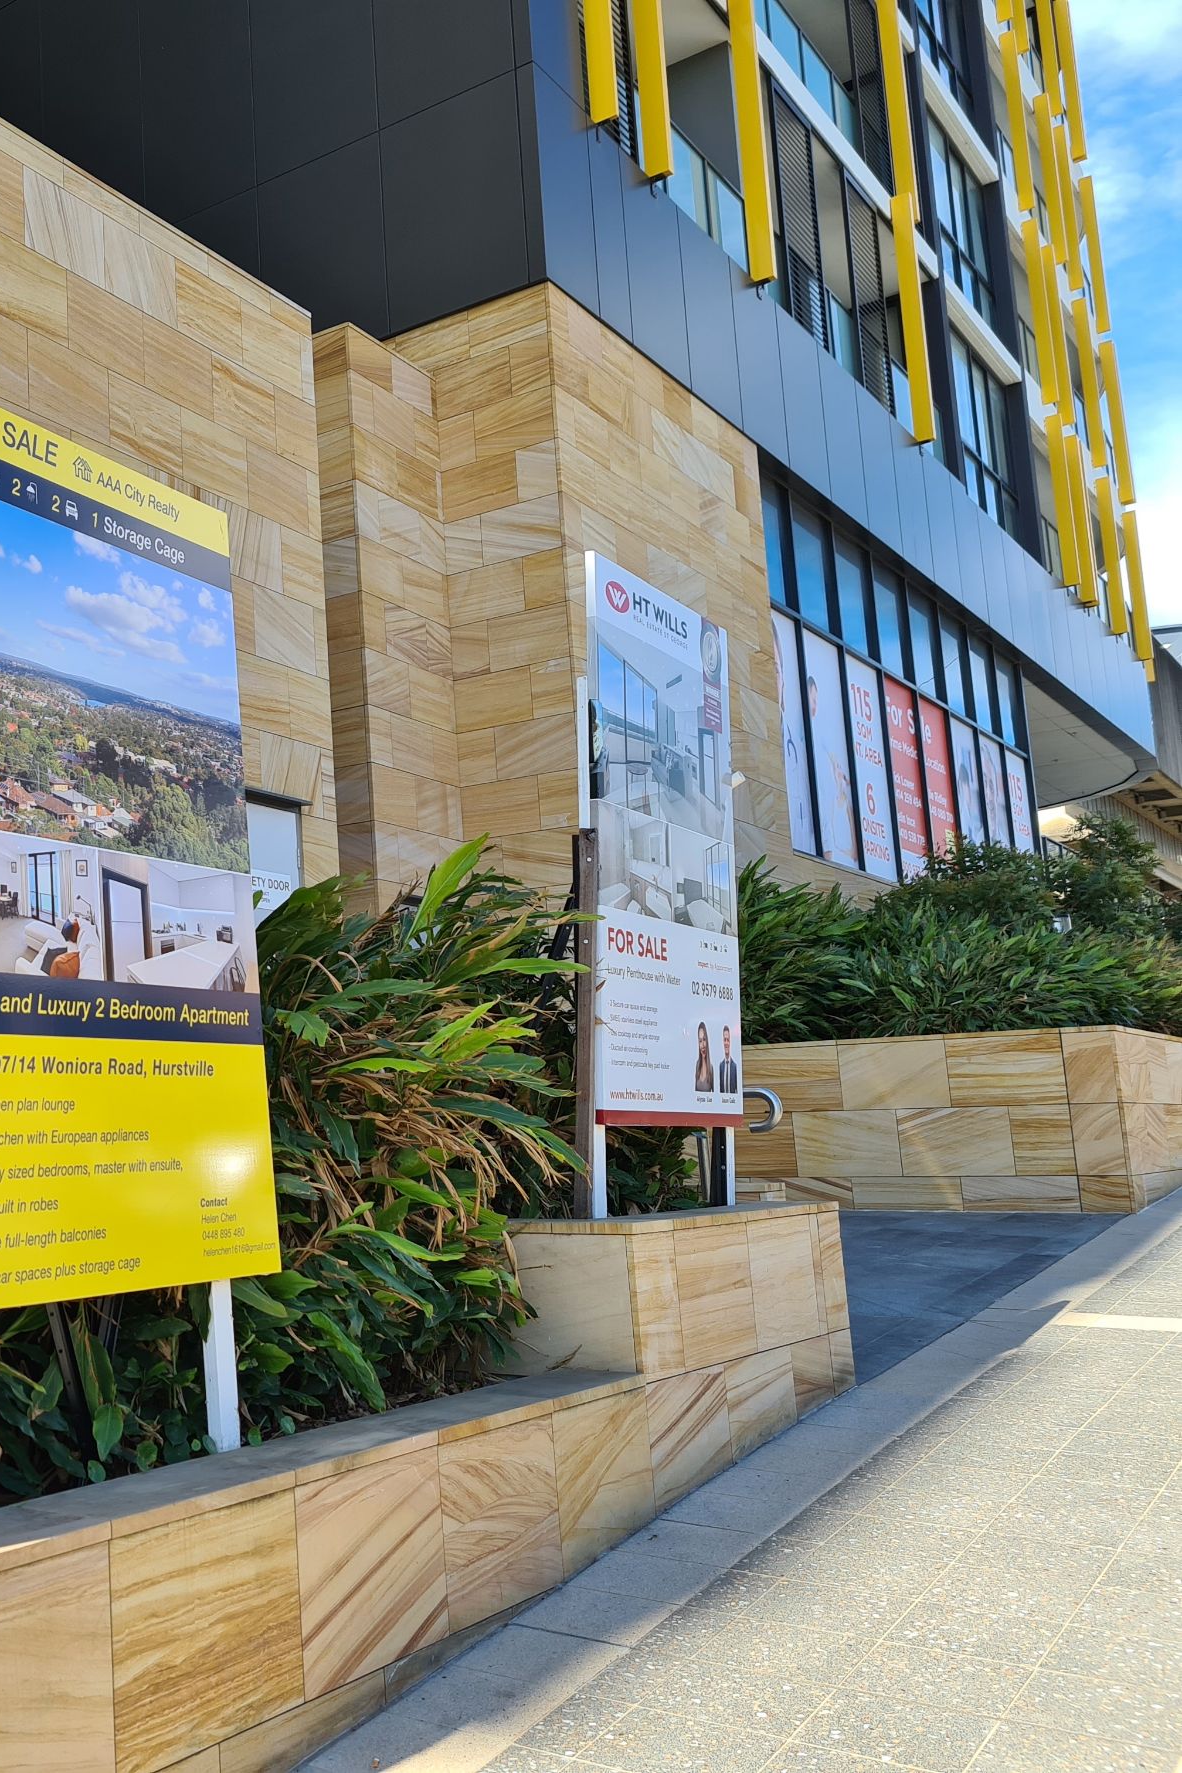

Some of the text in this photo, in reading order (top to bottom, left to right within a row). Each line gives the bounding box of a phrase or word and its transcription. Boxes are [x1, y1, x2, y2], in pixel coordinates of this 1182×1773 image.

[3, 421, 58, 468] SALE
[97, 471, 180, 523] AAA City Realty
[12, 478, 21, 497] 2
[51, 495, 60, 513] 2
[92, 512, 98, 528] 1
[104, 516, 152, 550] Storage
[155, 538, 185, 564] Cage
[633, 592, 688, 639] HT WILLS
[851, 683, 872, 722] 115
[866, 783, 877, 816] 6
[863, 818, 885, 839] ONSITE
[268, 879, 290, 891] DOOR
[608, 927, 634, 955] FOR
[638, 933, 667, 961] SALE
[627, 967, 653, 982] Penthouse
[692, 981, 700, 995] 02
[702, 984, 716, 997] 9579
[0, 992, 31, 1014] and
[37, 994, 91, 1021] Luxury
[96, 998, 105, 1018] 2
[110, 1000, 175, 1021] Bedroom
[180, 1003, 249, 1027] Apartment
[42, 1057, 102, 1075] Woniora
[108, 1058, 147, 1078] Road,
[152, 1059, 214, 1077] Hurstville
[17, 1098, 39, 1114] plan
[42, 1098, 75, 1114] lounge
[27, 1131, 48, 1144] with
[51, 1130, 98, 1146] European
[100, 1129, 149, 1144] appliances
[7, 1166, 34, 1180] sized
[38, 1163, 90, 1179] bedrooms,
[94, 1162, 125, 1175] master
[128, 1161, 147, 1173] with
[149, 1159, 183, 1172] ensuite,
[17, 1200, 26, 1213] in
[29, 1198, 58, 1212] robes
[201, 1198, 227, 1207] Contact
[201, 1212, 236, 1224] Helen Chen
[5, 1230, 57, 1249] full-length
[60, 1227, 107, 1243] balconies
[15, 1267, 52, 1285] spaces
[55, 1264, 76, 1280] plus
[79, 1259, 115, 1276] storage
[118, 1257, 141, 1272] cage
